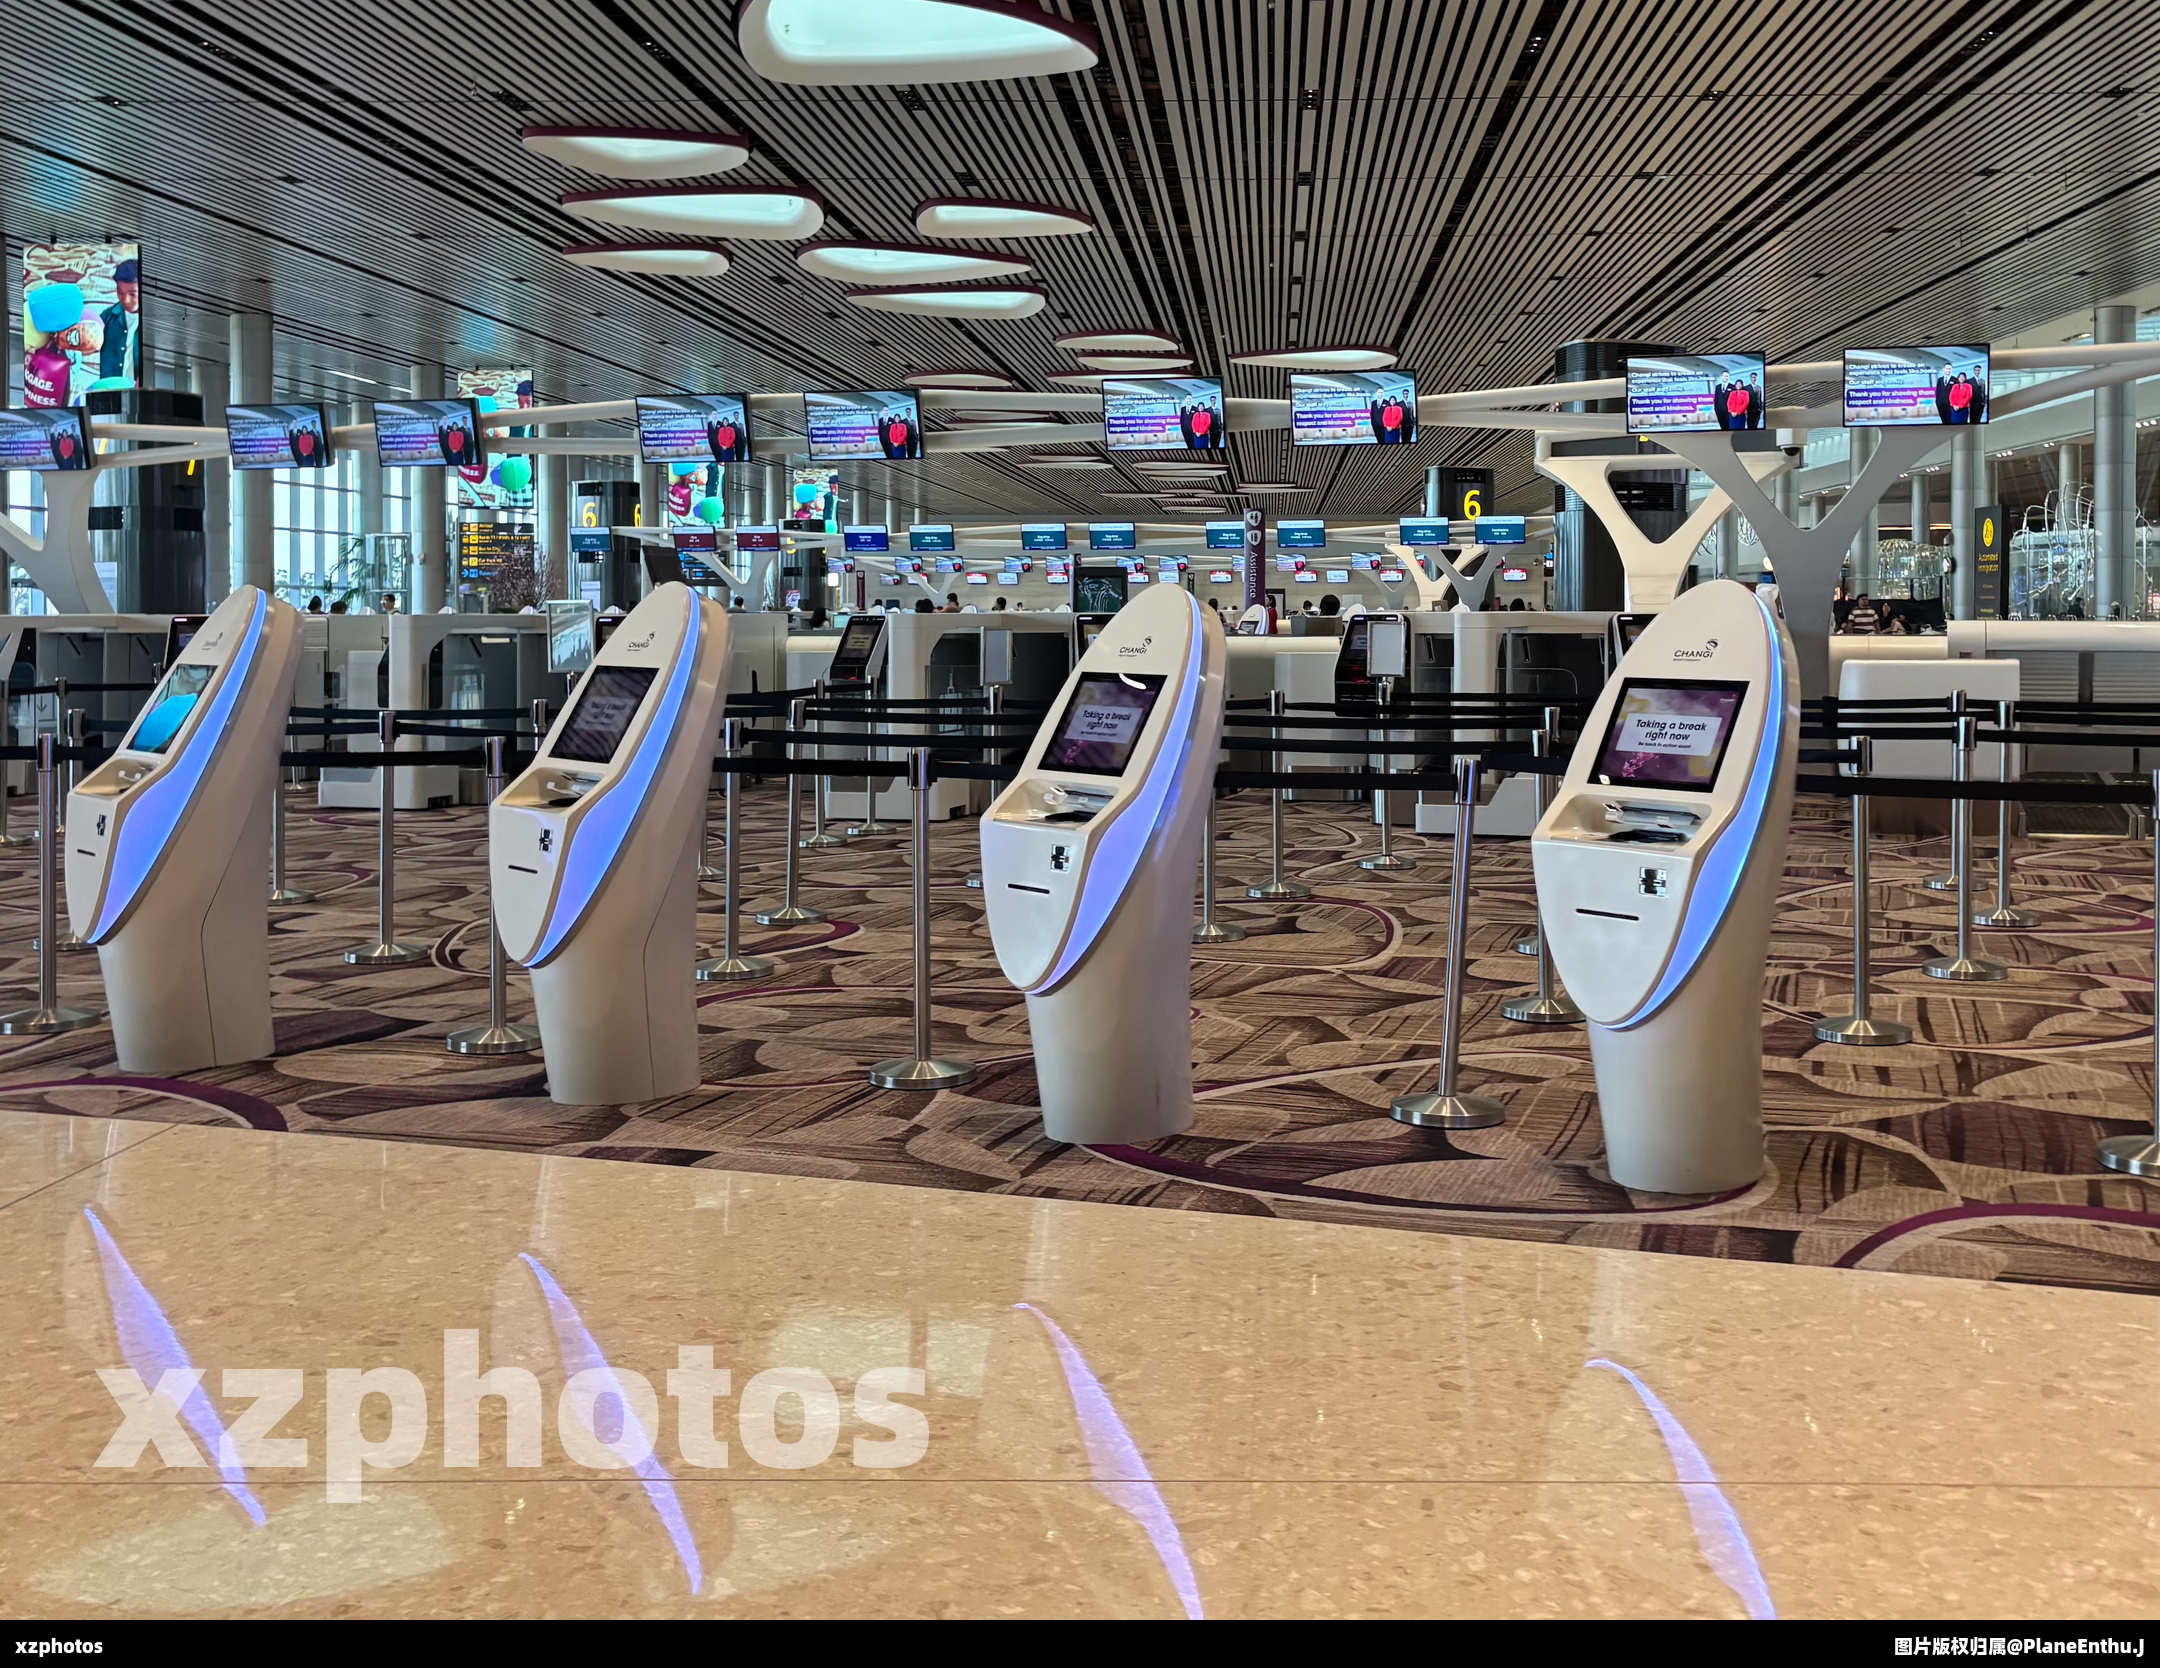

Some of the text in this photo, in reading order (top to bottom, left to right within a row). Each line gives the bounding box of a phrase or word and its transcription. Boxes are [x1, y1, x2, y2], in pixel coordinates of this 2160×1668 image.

[1464, 490, 1481, 521] 6
[583, 502, 597, 527] 6
[1250, 552, 1258, 598] Assistance
[1674, 650, 1713, 658] CHANGI
[1083, 710, 1104, 720] Taking
[1112, 712, 1132, 720] break
[1087, 721, 1102, 729] right
[1636, 720, 1666, 731] Taking
[1678, 722, 1707, 731] break
[1645, 730, 1668, 740] right
